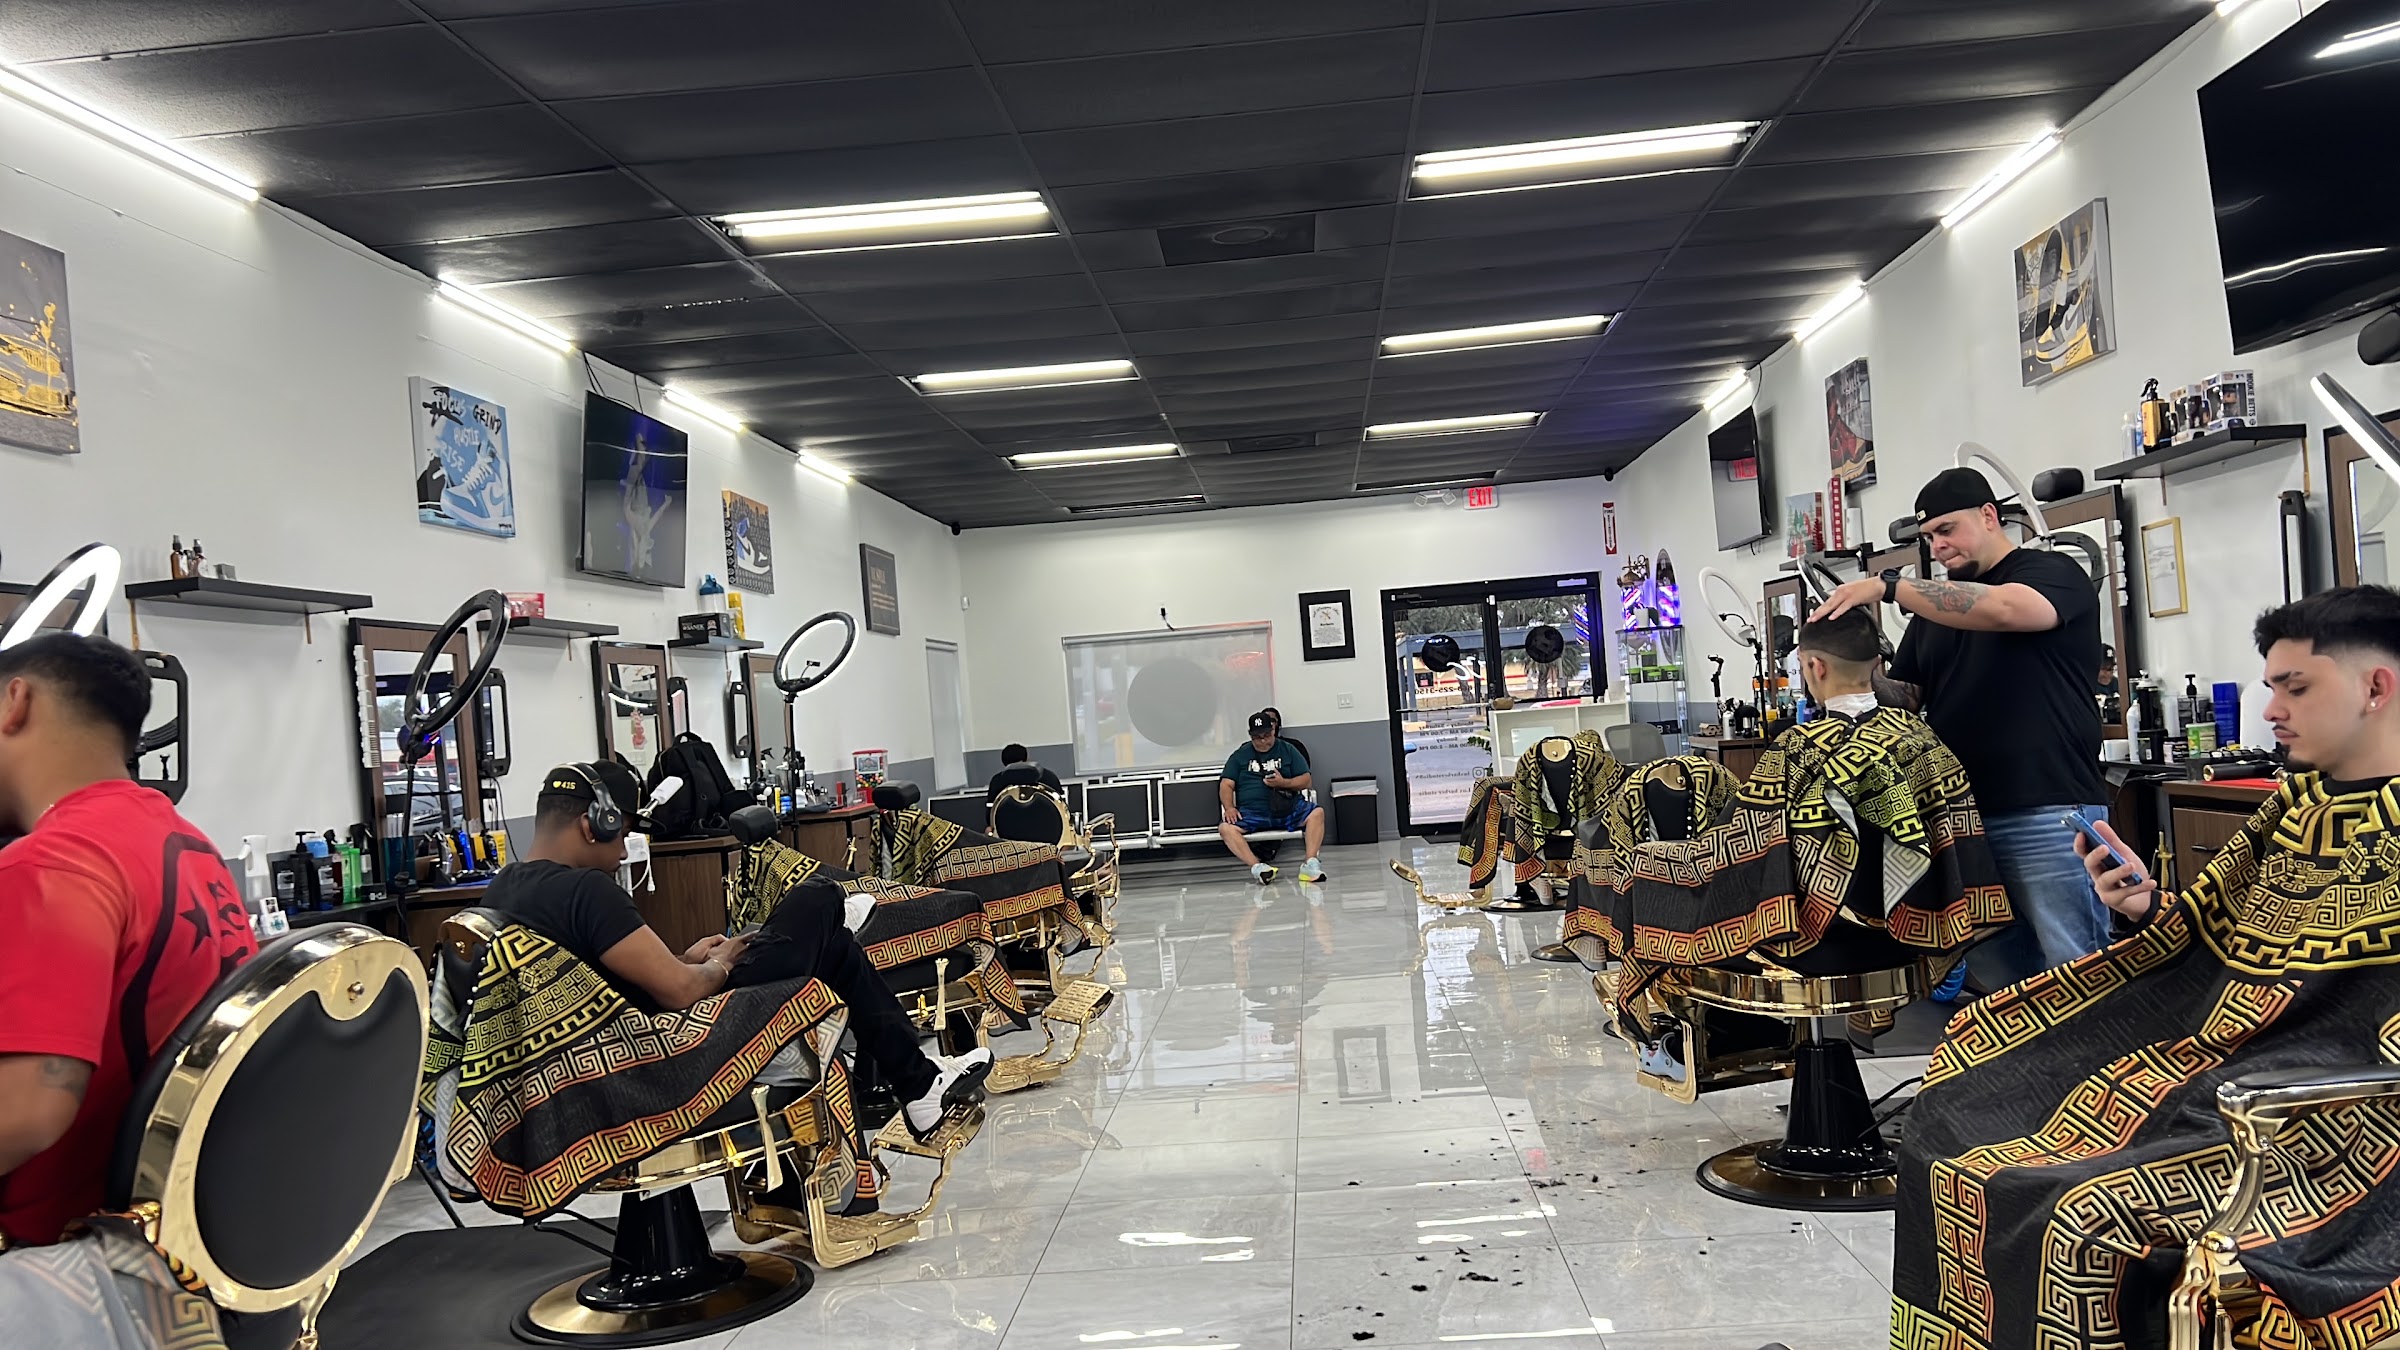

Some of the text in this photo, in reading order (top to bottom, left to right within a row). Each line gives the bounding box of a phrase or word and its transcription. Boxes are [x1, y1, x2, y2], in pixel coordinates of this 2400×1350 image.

[473, 405, 502, 434] GRIND
[440, 442, 465, 472] RISE
[1468, 487, 1493, 506] EXIT
[561, 781, 576, 790] 415
